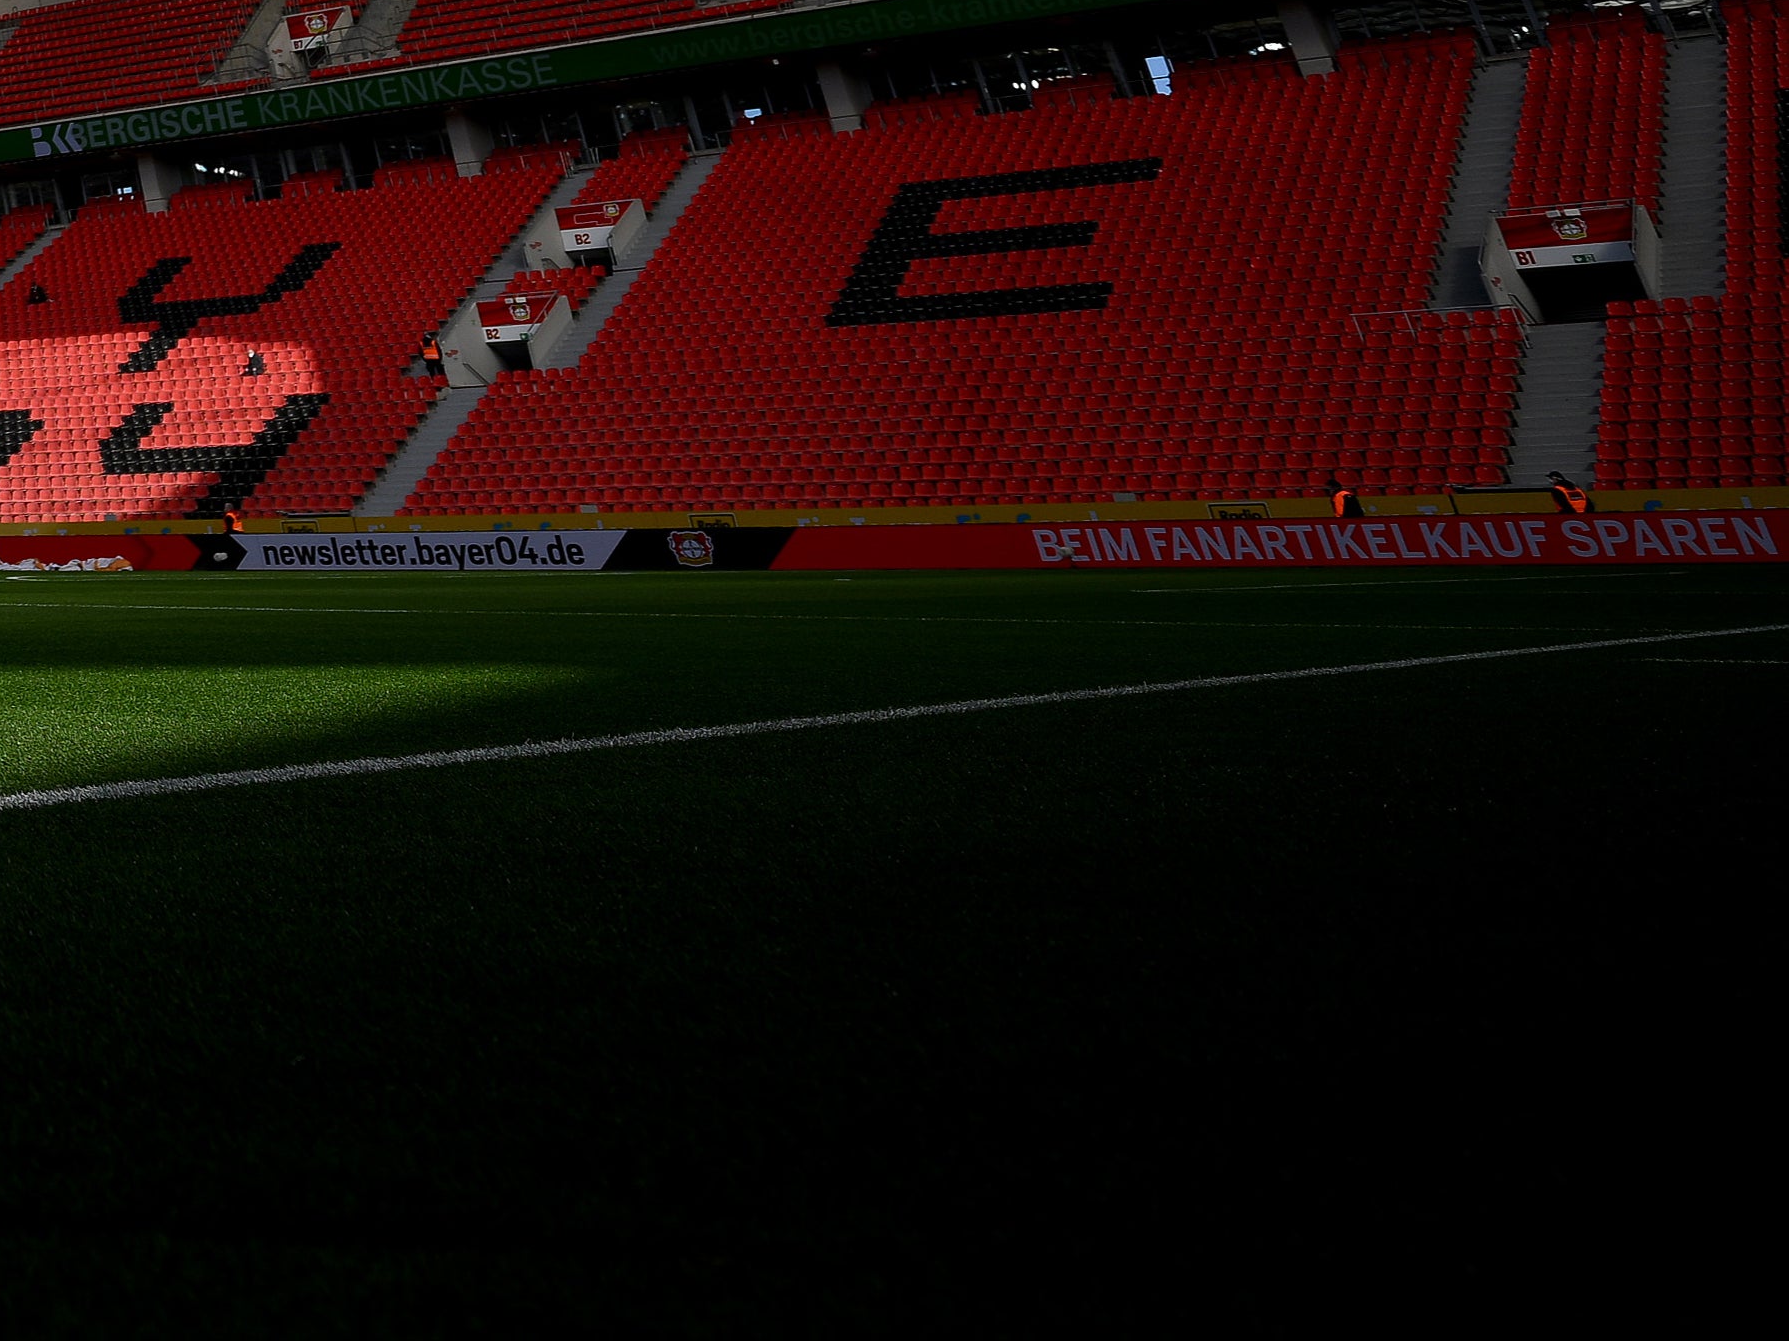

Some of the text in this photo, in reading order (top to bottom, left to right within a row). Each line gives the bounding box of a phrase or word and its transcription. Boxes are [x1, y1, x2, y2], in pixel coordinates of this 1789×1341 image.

[73, 53, 559, 151] BERGISCHE KRANKENKASSE
[575, 233, 592, 245] B2
[1515, 250, 1536, 266] B1
[486, 328, 500, 340] B2
[262, 534, 585, 570] newsletter.bayer04.de
[1032, 516, 1779, 563] BEIM FANARTIKELKAUF SPAREN
